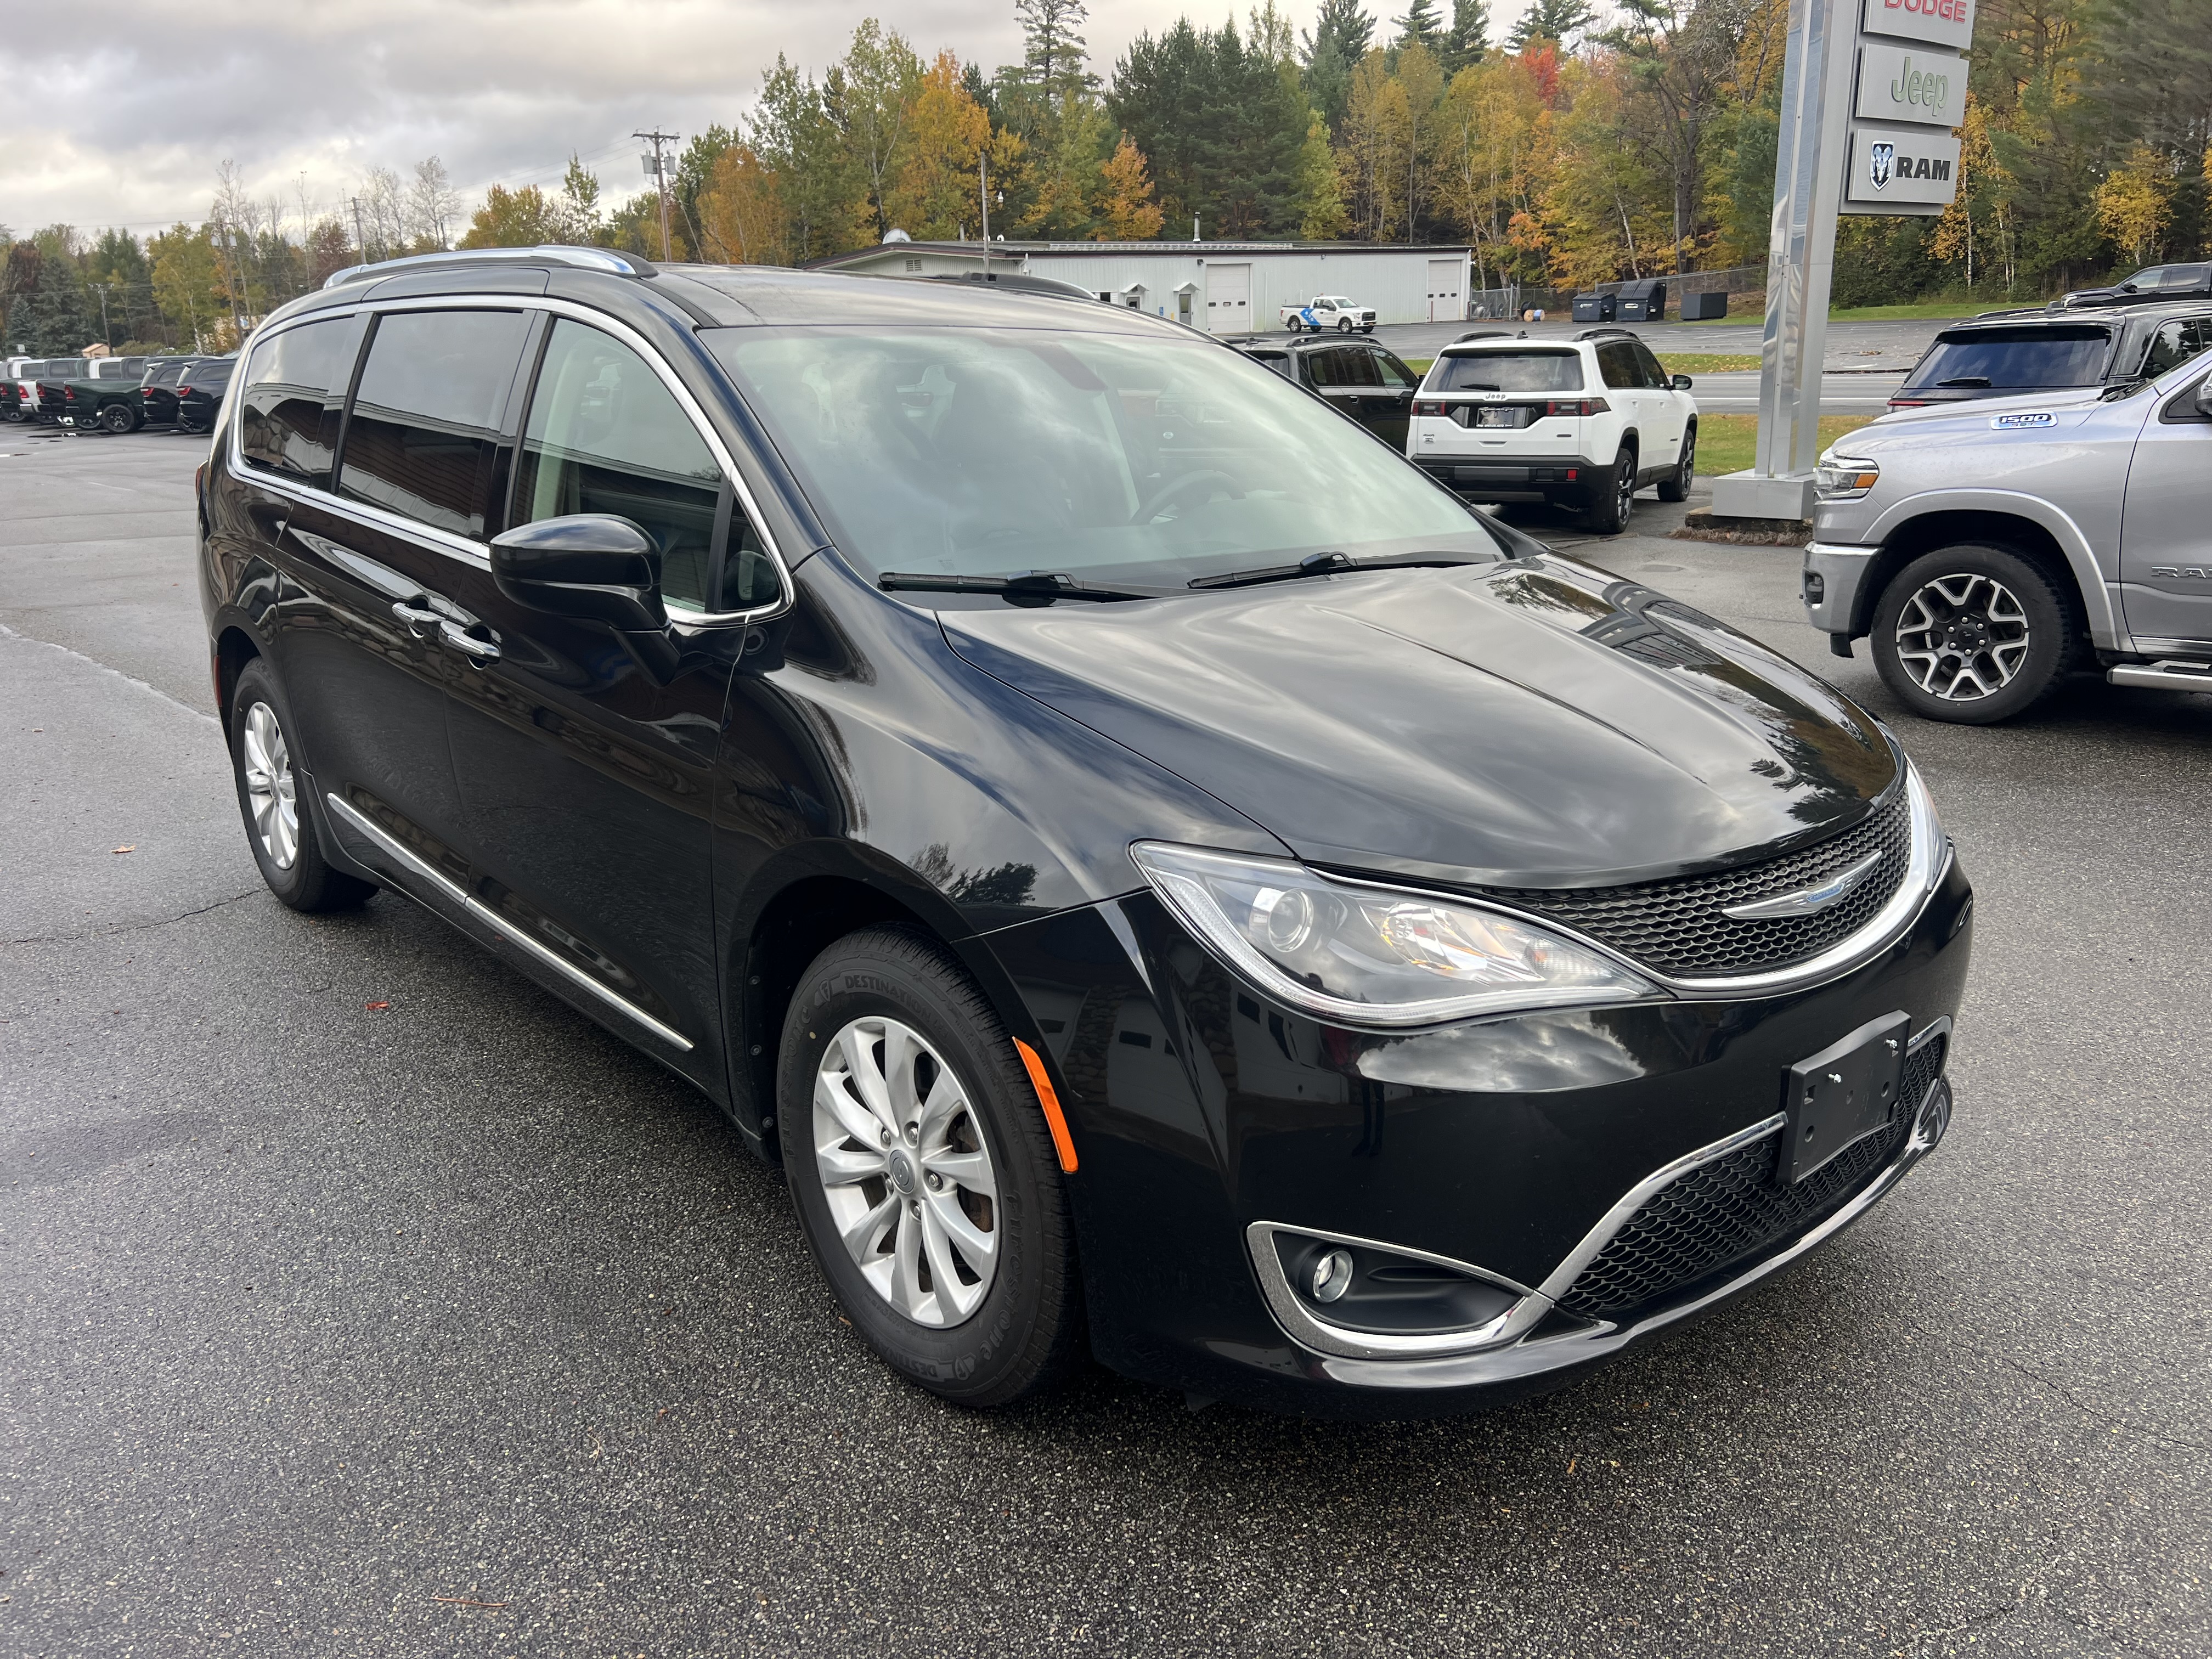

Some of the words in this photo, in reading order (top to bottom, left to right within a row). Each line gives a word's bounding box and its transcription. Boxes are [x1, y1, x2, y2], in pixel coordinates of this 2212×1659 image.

[1891, 57, 1949, 117] Jeep
[1895, 156, 1951, 181] RAM
[2001, 415, 2049, 424] 1500
[2151, 566, 2212, 579] RA
[1809, 885, 1841, 900] CHRYSLER
[844, 974, 931, 1022] DESTINATION
[781, 1005, 811, 1158] Firestone
[980, 1190, 1025, 1361] Firestone
